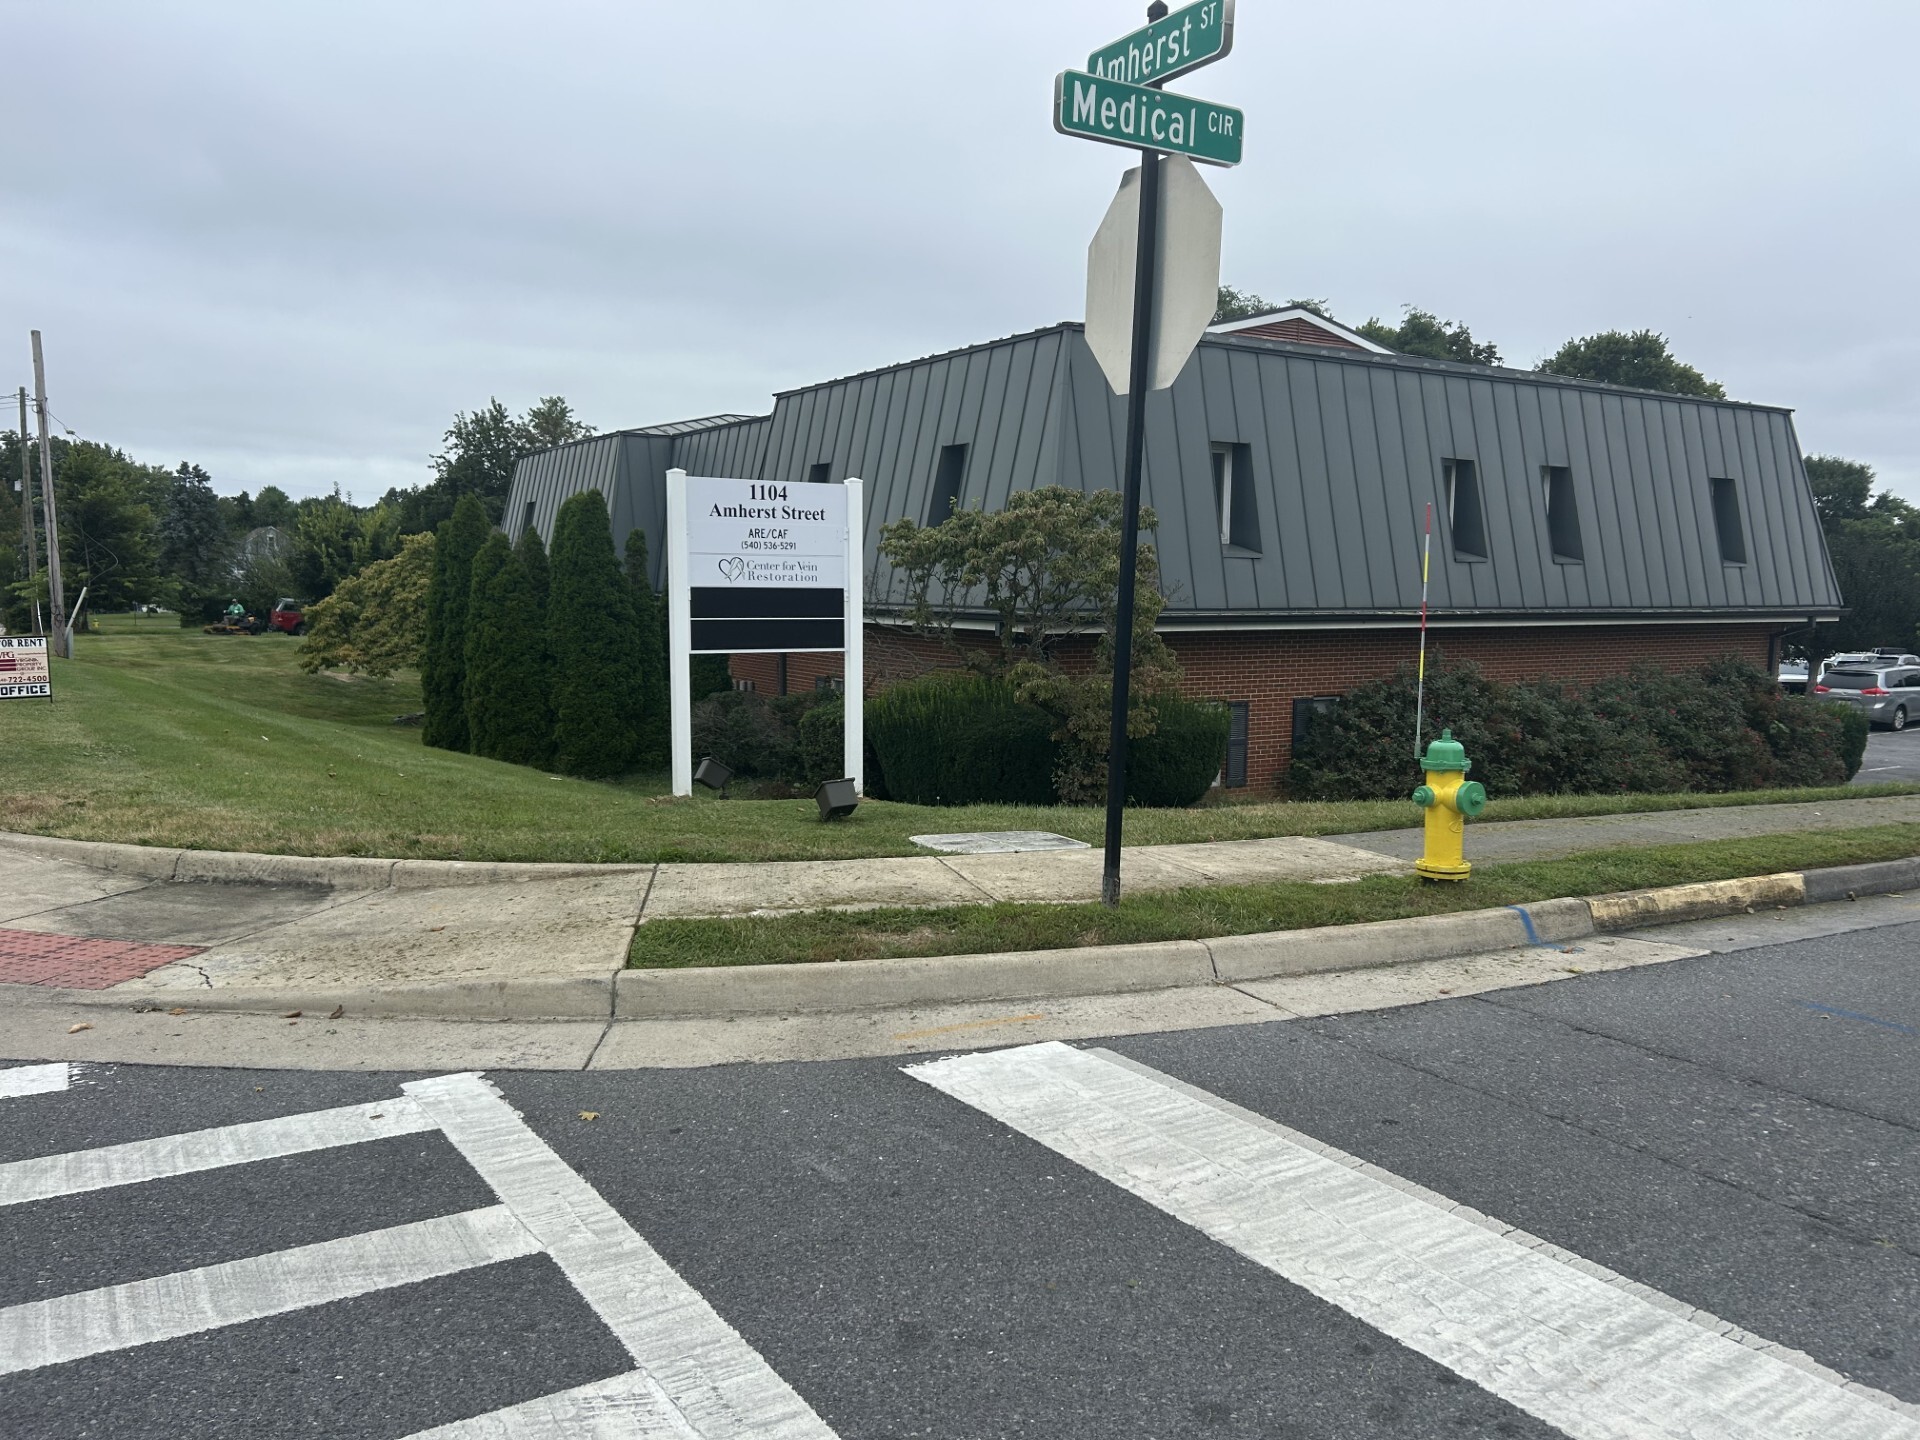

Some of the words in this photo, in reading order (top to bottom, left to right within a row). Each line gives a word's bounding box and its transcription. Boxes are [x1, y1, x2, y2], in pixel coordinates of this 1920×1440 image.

[1095, 15, 1192, 82] Amherst
[1200, 2, 1217, 29] ST
[1072, 80, 1196, 147] Medical
[1208, 111, 1234, 137] CIR
[749, 484, 788, 501] 1104
[709, 503, 777, 519] Amherst
[781, 505, 826, 521] Street
[748, 528, 788, 539] ARE/CAF
[741, 541, 762, 550] (540)
[763, 541, 797, 551] 536-5291
[746, 559, 780, 571] Center
[782, 560, 796, 571] for
[797, 561, 818, 572] Vein
[747, 570, 818, 582] Restoration
[0, 639, 14, 648] OR
[17, 638, 44, 647] RENT
[0, 685, 47, 695] OFFICE
